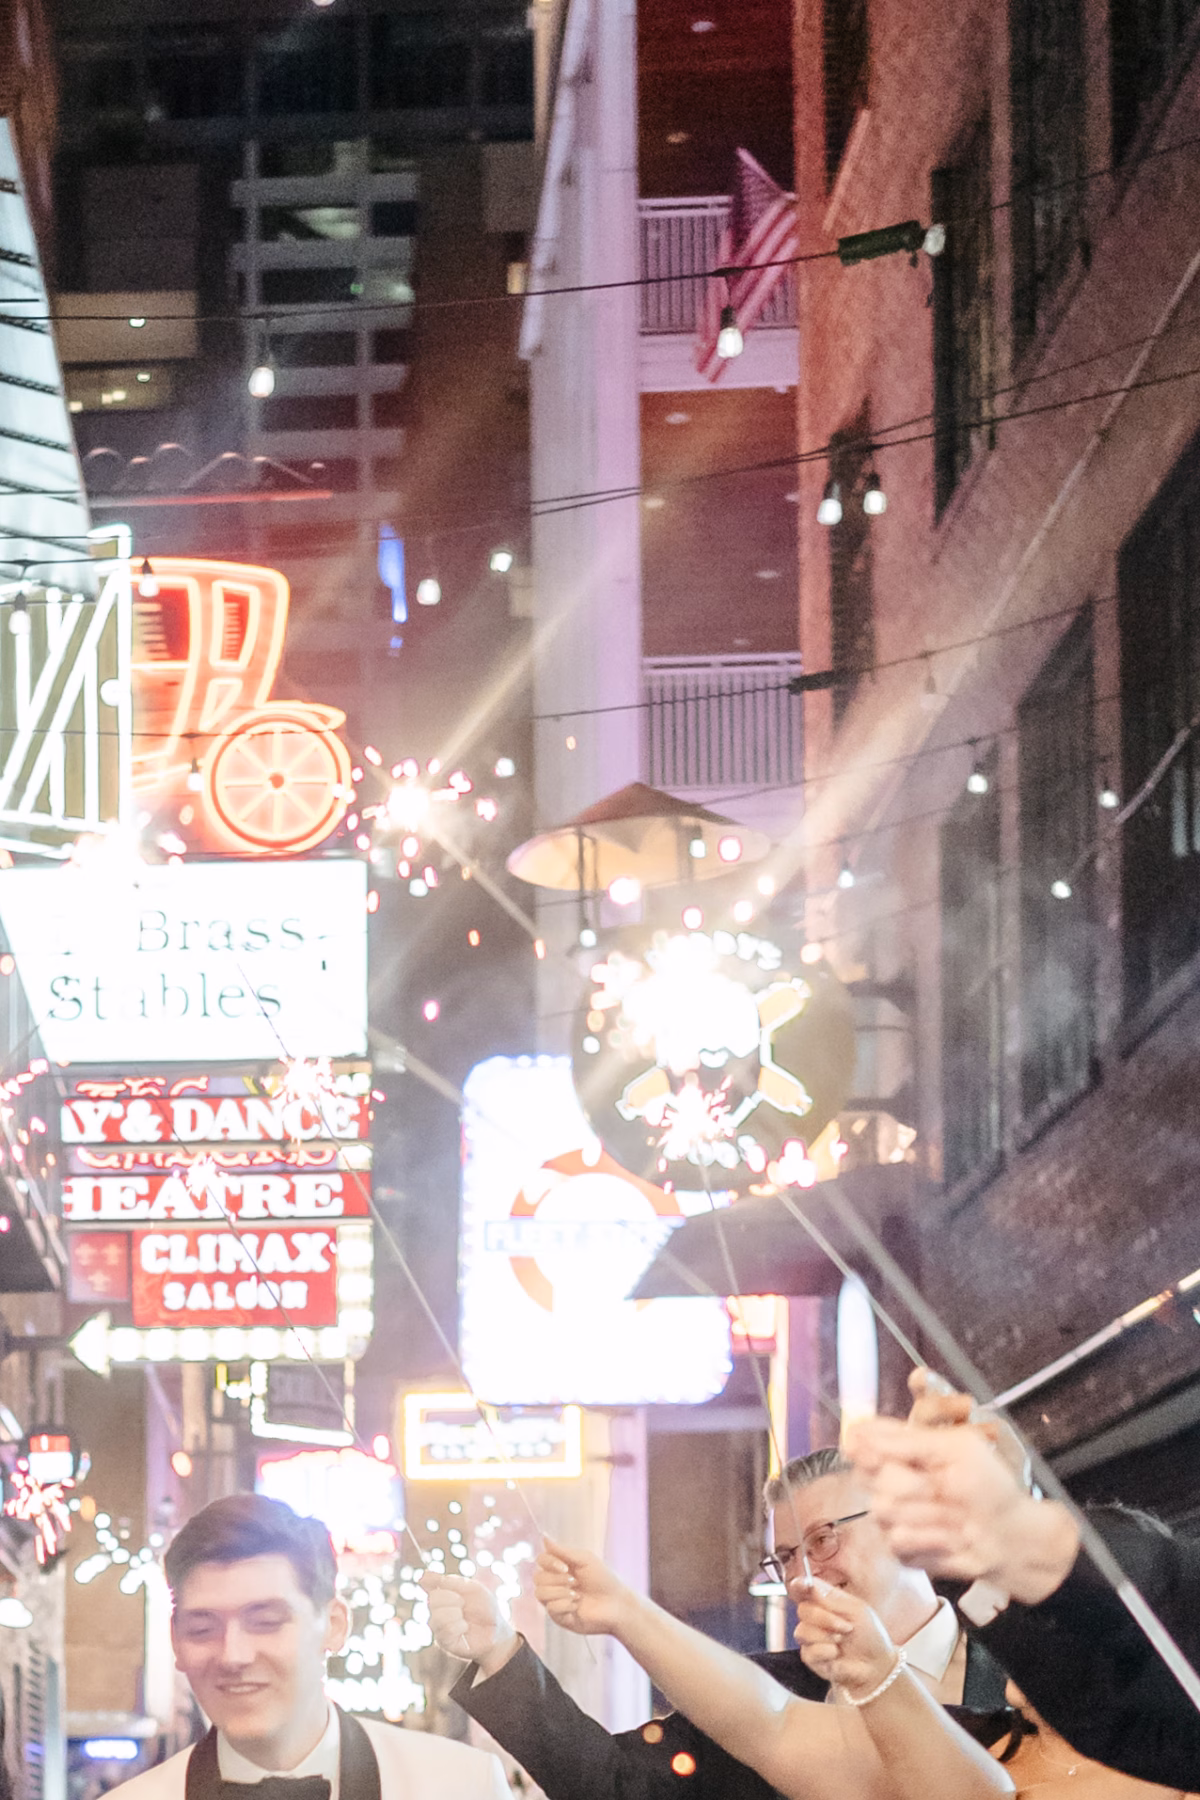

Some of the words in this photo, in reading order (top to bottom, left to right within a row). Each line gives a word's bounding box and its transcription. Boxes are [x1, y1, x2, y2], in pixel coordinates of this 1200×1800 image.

[137, 909, 305, 952] Brass
[48, 971, 282, 1021] Stables
[119, 1098, 163, 1142] &
[170, 1098, 361, 1141] DANCE
[140, 1231, 331, 1275] CLIMAX
[163, 1280, 308, 1312] SALOON
